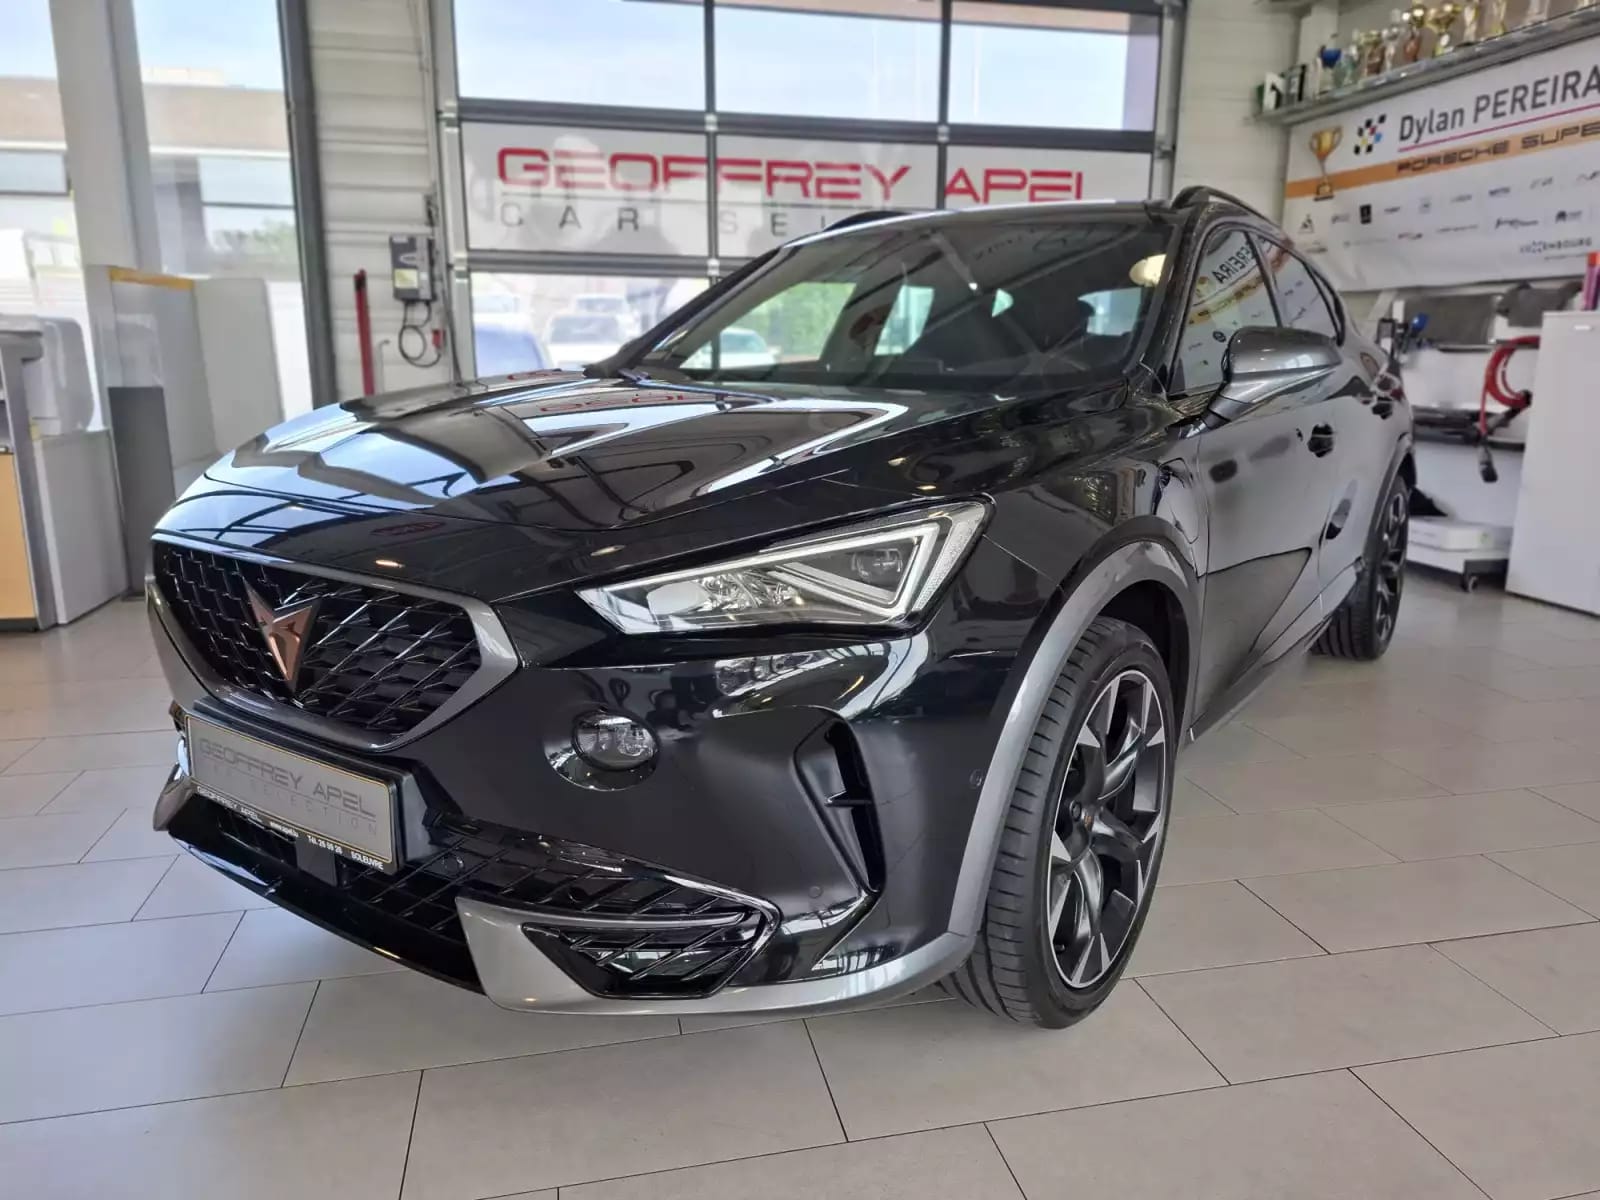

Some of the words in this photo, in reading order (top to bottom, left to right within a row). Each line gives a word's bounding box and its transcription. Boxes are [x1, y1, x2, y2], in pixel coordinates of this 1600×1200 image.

[1399, 108, 1465, 144] Dylan
[1473, 64, 1600, 124] PEREIRA
[497, 147, 911, 201] GEOFFREY
[1397, 139, 1509, 173] PORSCHE
[500, 203, 640, 232] CAR
[200, 738, 303, 790] GEOFFREY
[312, 781, 376, 818] APEL
